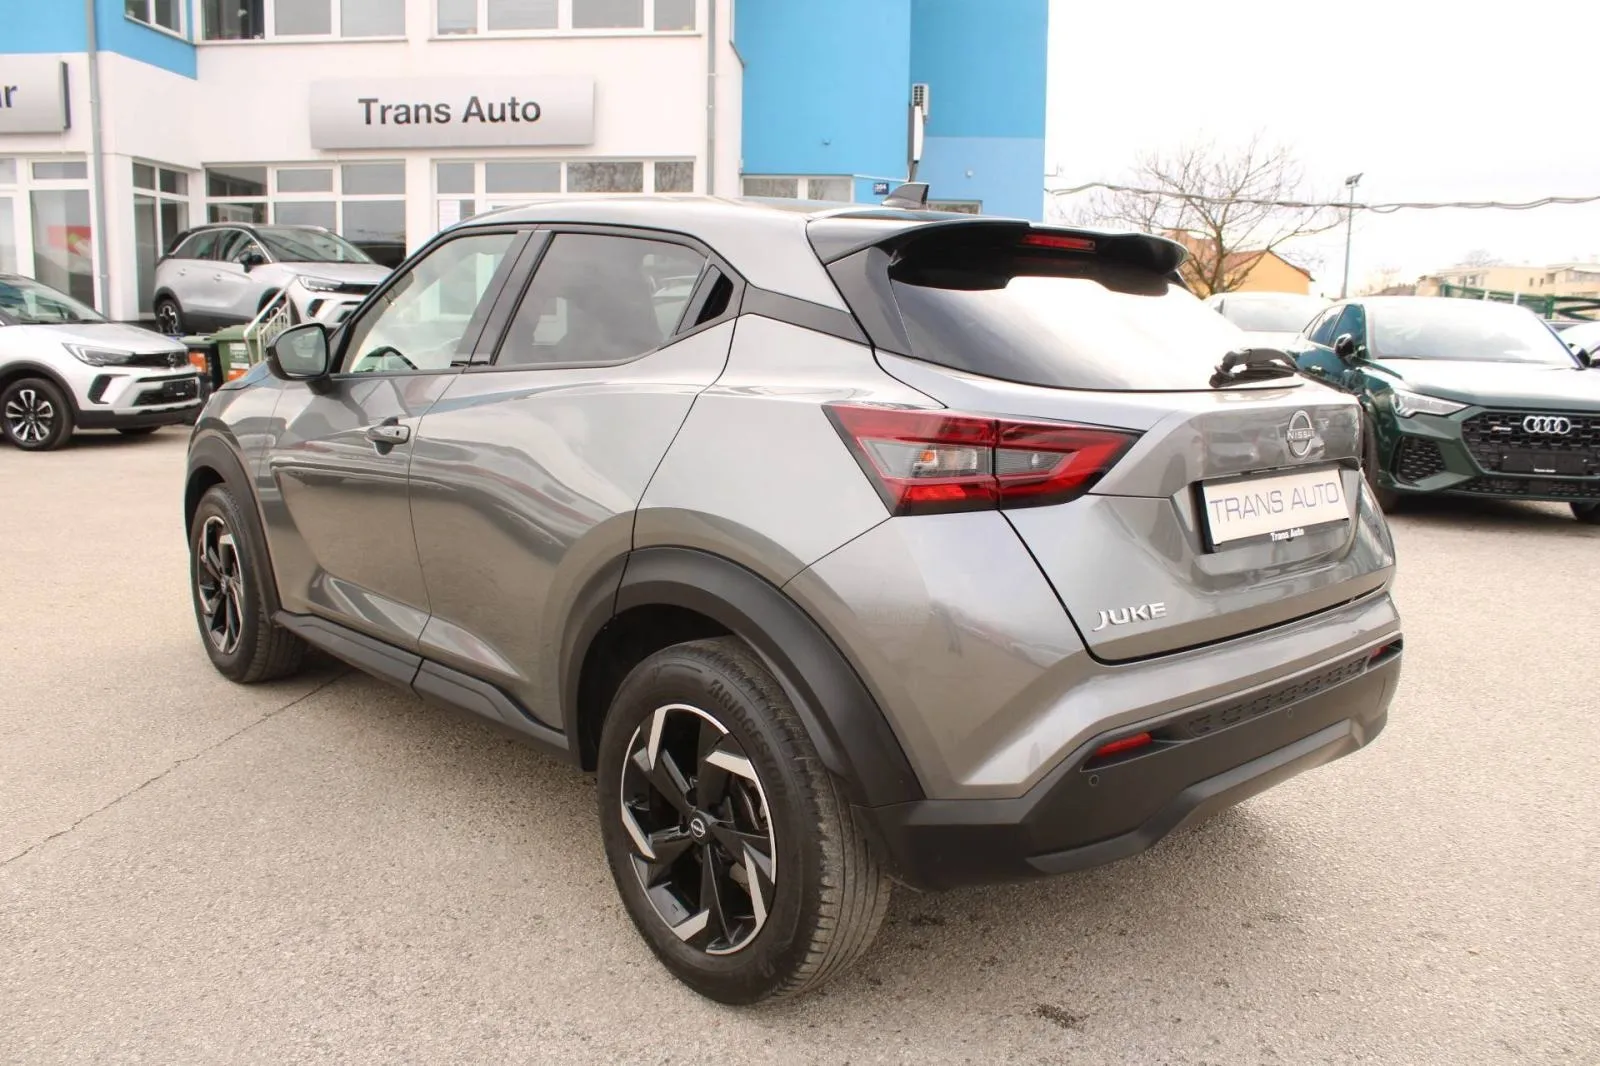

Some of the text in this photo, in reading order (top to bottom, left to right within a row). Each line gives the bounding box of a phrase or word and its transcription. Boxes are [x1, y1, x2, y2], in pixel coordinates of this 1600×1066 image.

[0, 85, 18, 108] r
[358, 95, 541, 125] Trans Auto
[1209, 482, 1340, 523] TRANS AUTO
[1270, 527, 1305, 542] Trans Auto
[1092, 602, 1167, 632] JUKE
